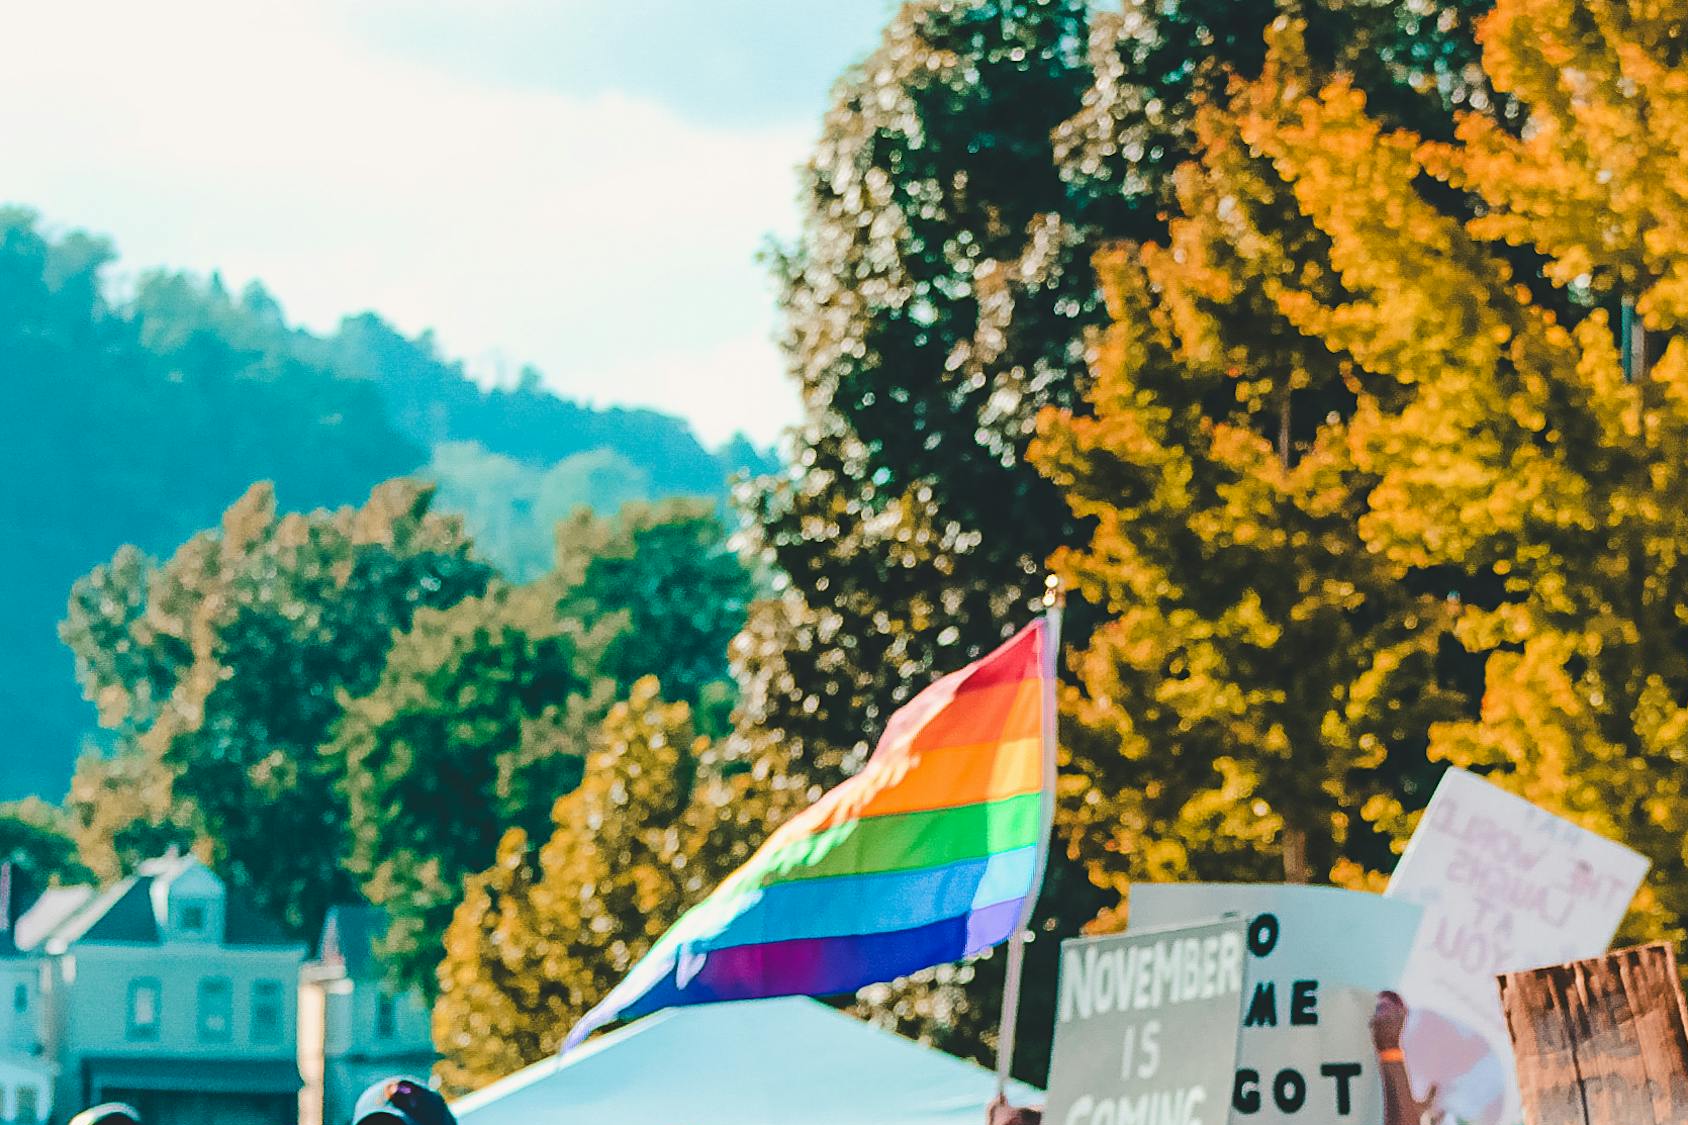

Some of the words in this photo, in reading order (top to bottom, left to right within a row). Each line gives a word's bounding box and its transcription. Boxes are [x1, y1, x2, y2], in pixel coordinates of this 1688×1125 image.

[1247, 913, 1281, 958] O
[1062, 933, 1243, 1022] NOVEMBER
[1244, 980, 1319, 1027] ME
[1121, 1022, 1161, 1080] IS
[1232, 1062, 1362, 1116] GOT
